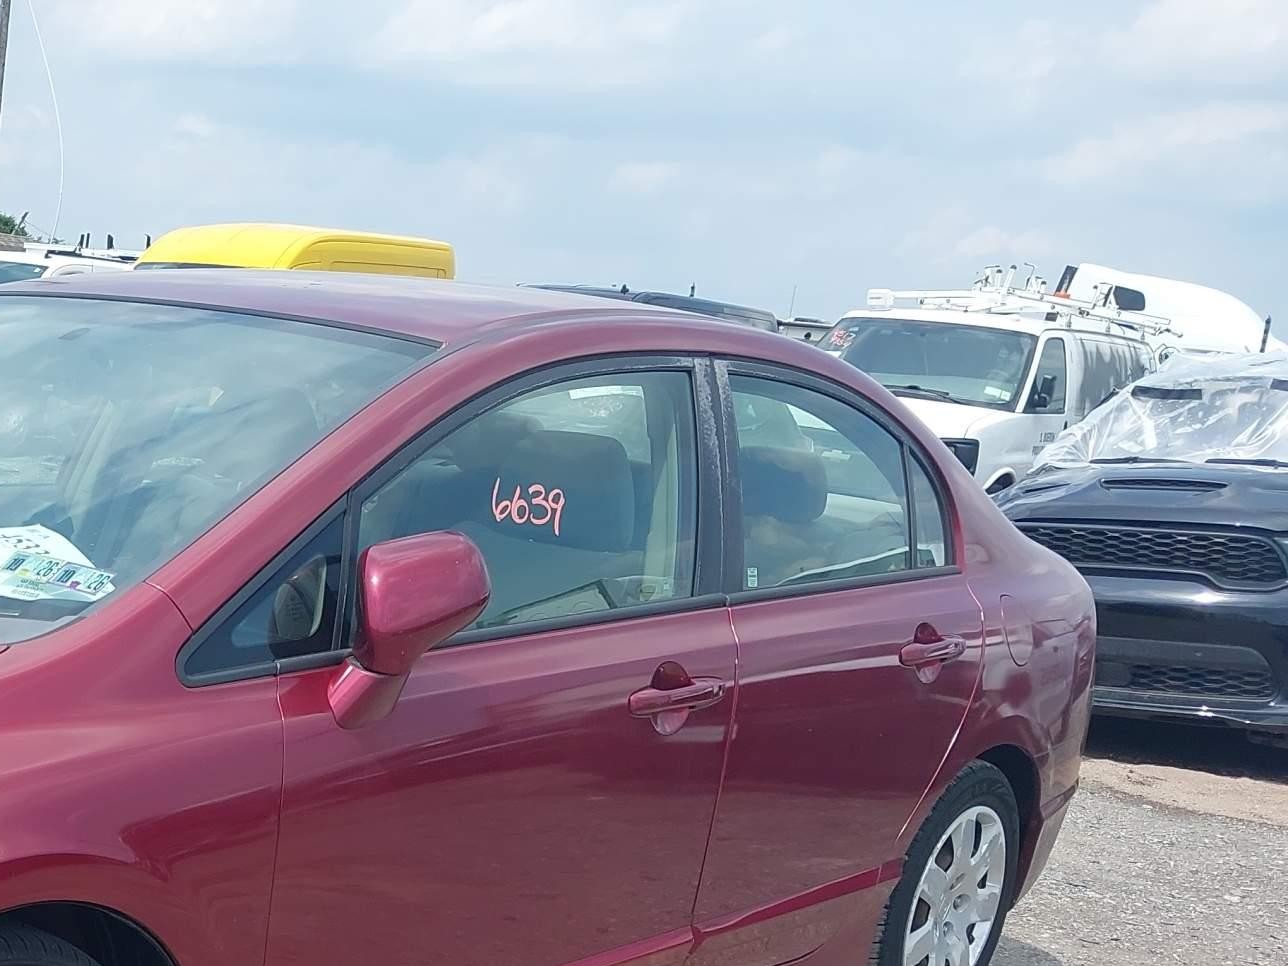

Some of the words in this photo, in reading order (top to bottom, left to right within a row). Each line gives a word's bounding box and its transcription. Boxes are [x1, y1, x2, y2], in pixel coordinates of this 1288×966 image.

[491, 476, 565, 537] 6639
[36, 560, 59, 577] 26
[87, 573, 111, 591] 26
